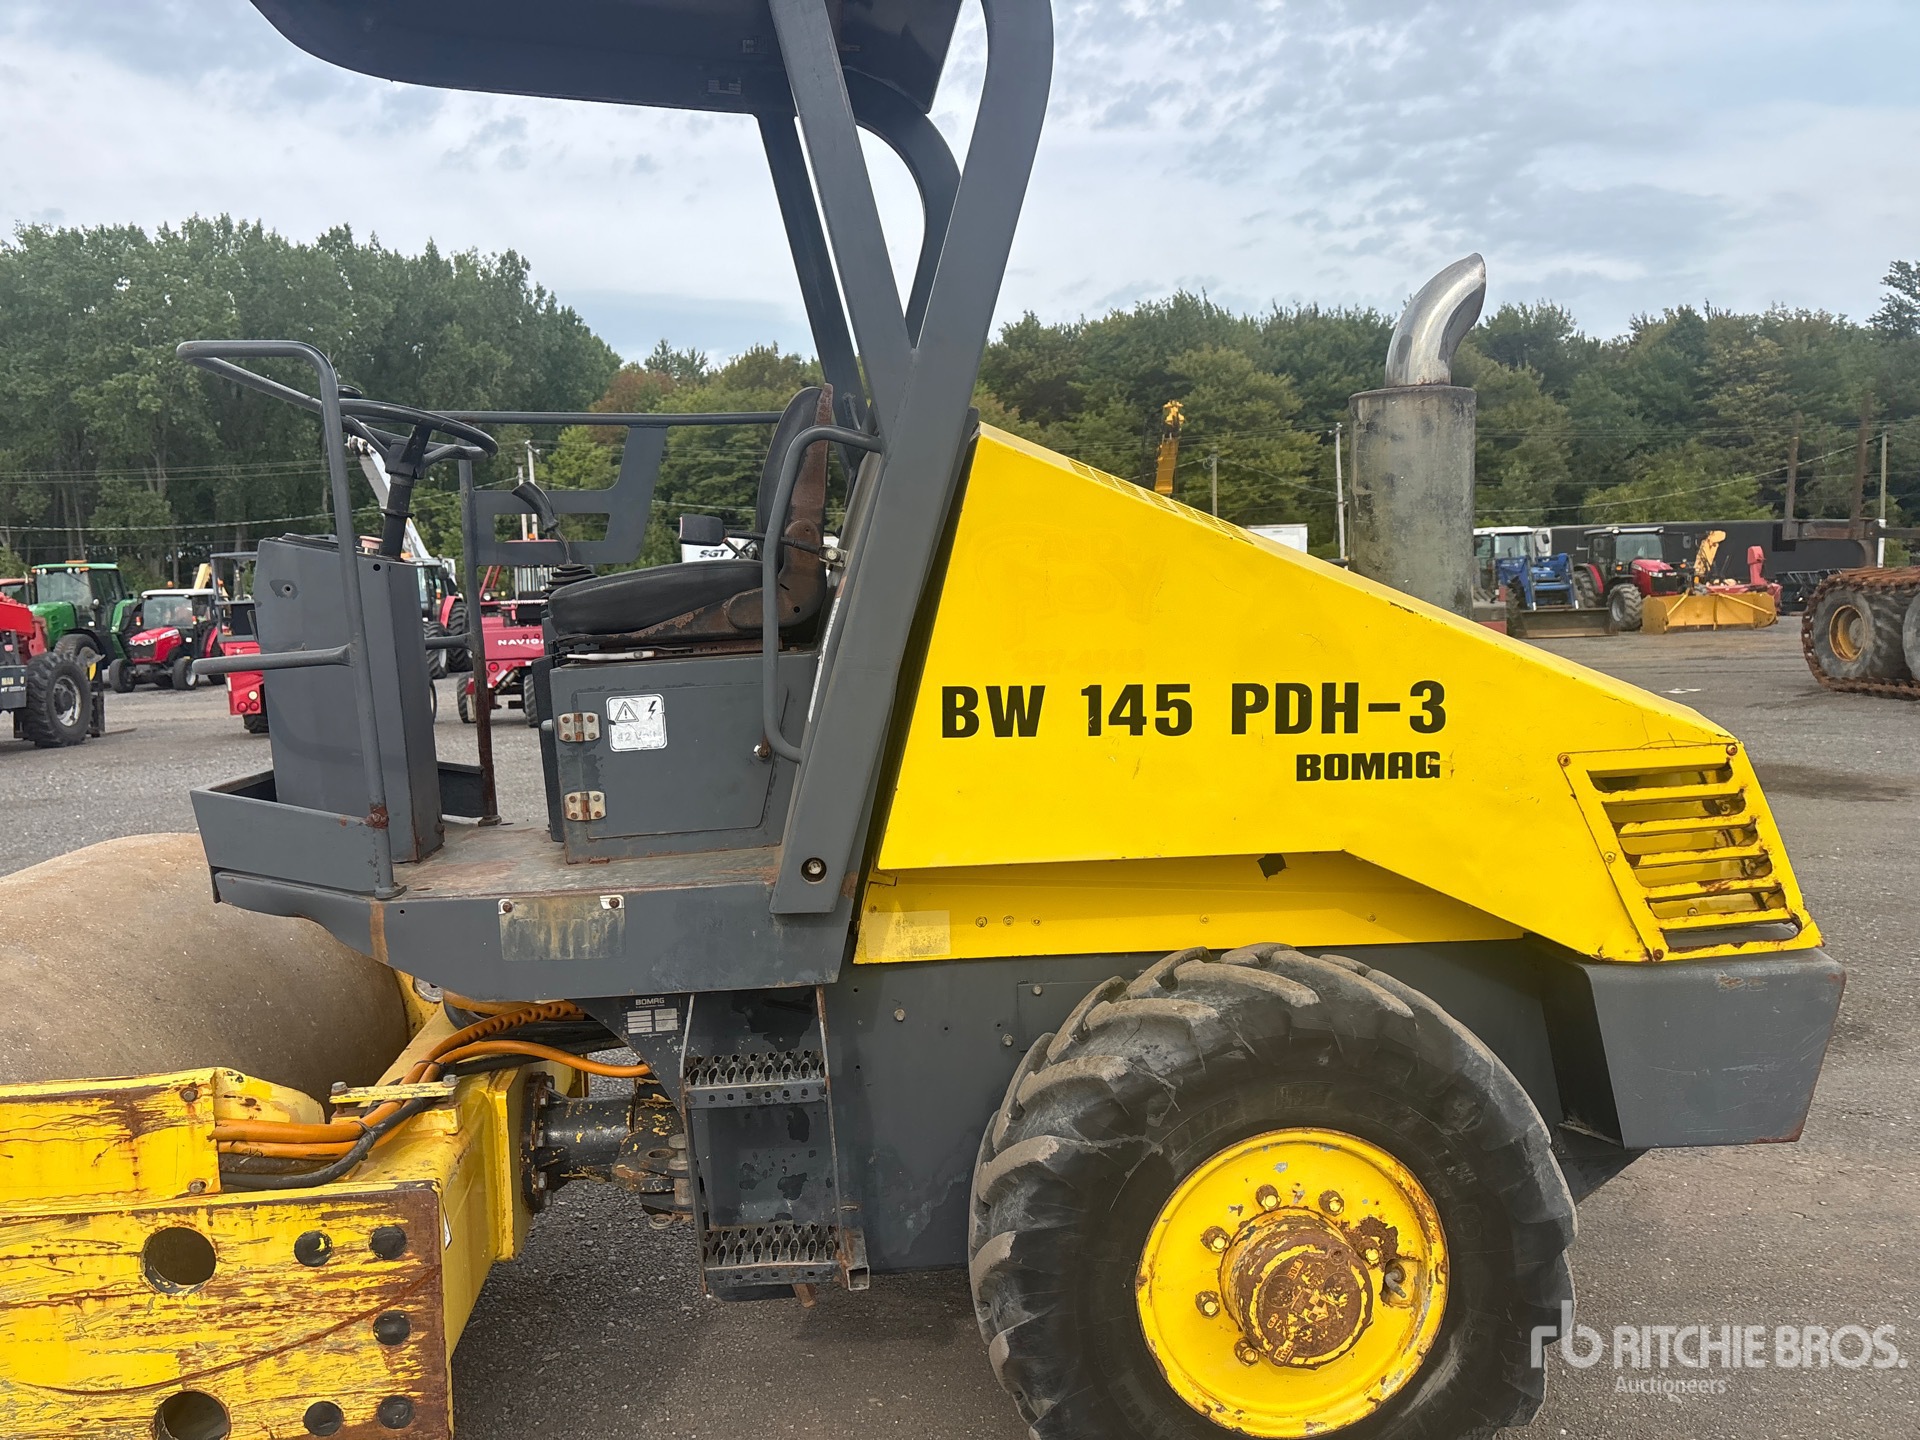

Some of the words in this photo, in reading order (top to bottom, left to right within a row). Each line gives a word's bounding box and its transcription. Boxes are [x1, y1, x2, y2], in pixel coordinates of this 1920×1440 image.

[699, 548, 729, 558] SGT
[941, 684, 1046, 738] BW
[1081, 683, 1194, 737] 145
[1231, 680, 1447, 735] PDH-3
[1296, 751, 1441, 782] BOMAG
[635, 997, 665, 1006] BOMAG
